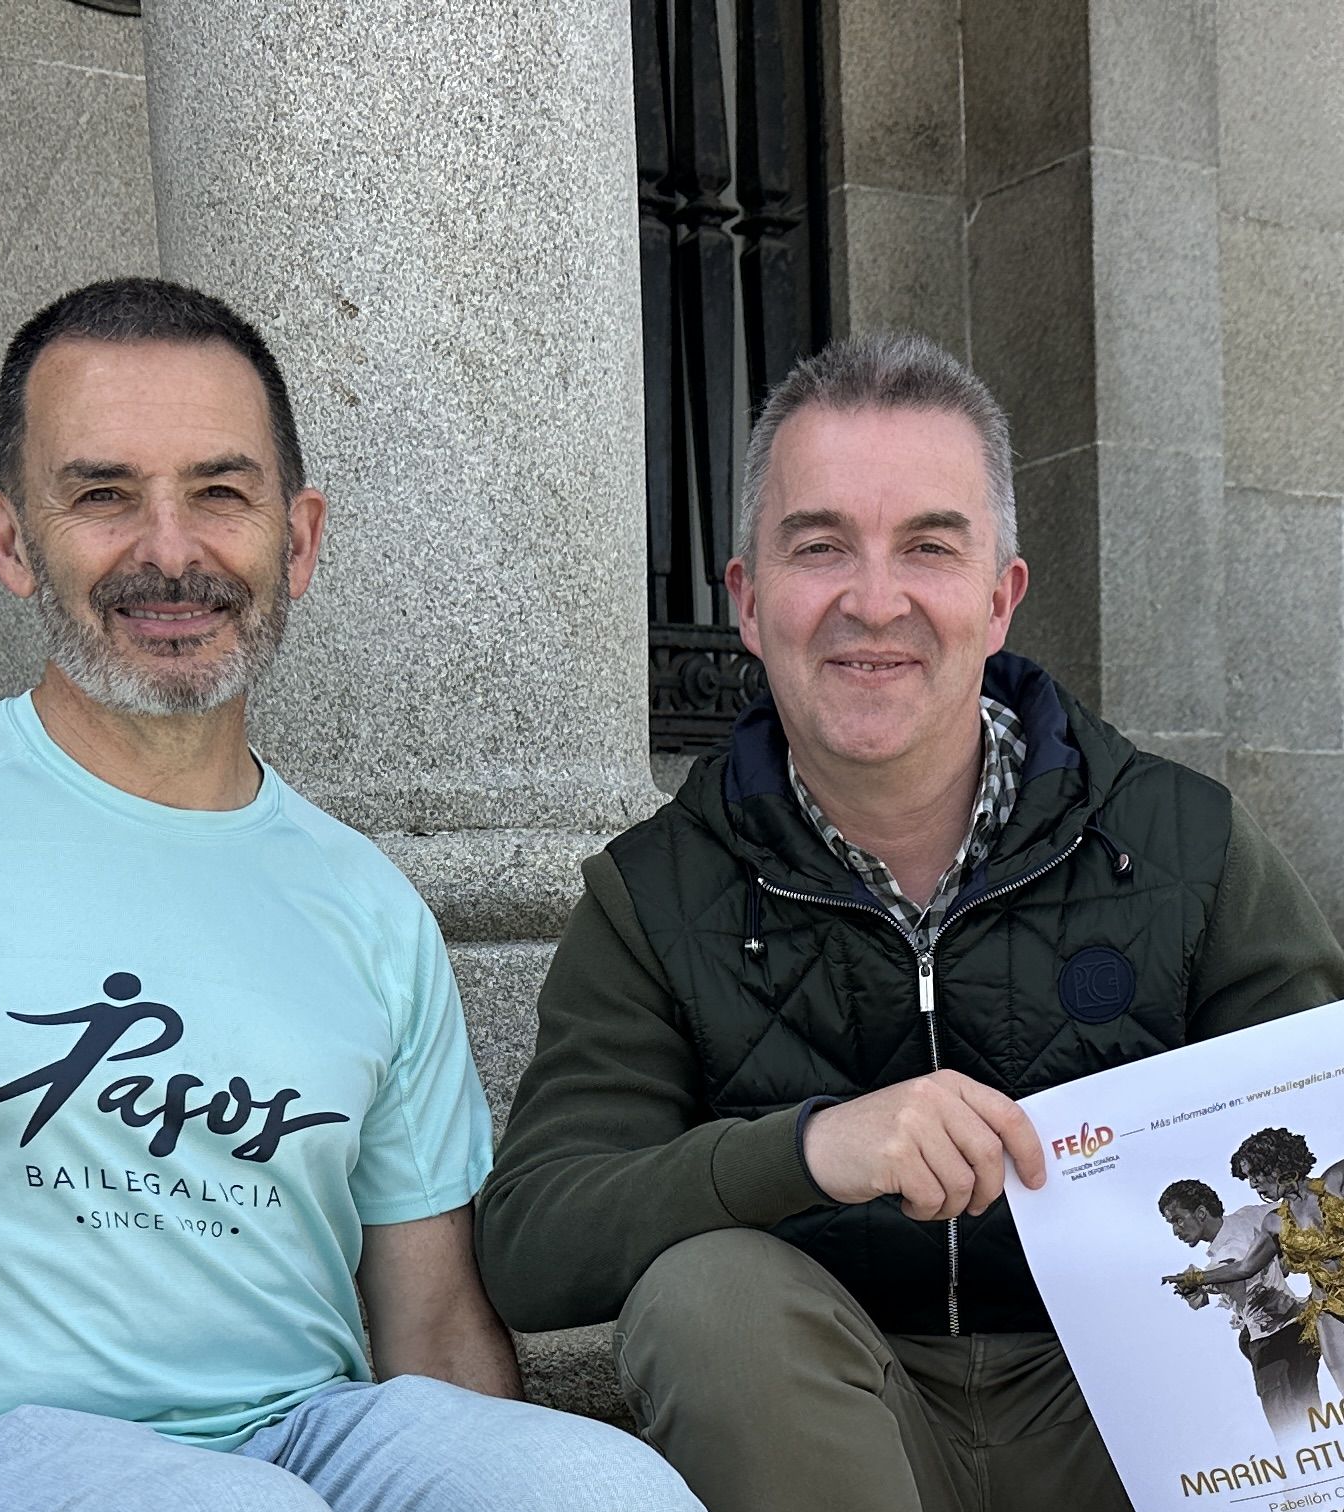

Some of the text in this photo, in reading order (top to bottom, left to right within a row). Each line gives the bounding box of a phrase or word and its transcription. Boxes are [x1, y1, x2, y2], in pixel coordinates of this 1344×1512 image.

[1150, 1118, 1171, 1131] Más
[1172, 1102, 1227, 1124] información
[25, 1164, 282, 1208] BAILEGALICIA
[90, 1210, 224, 1238] SINCE 1990
[1180, 1454, 1287, 1497] MARÍN
